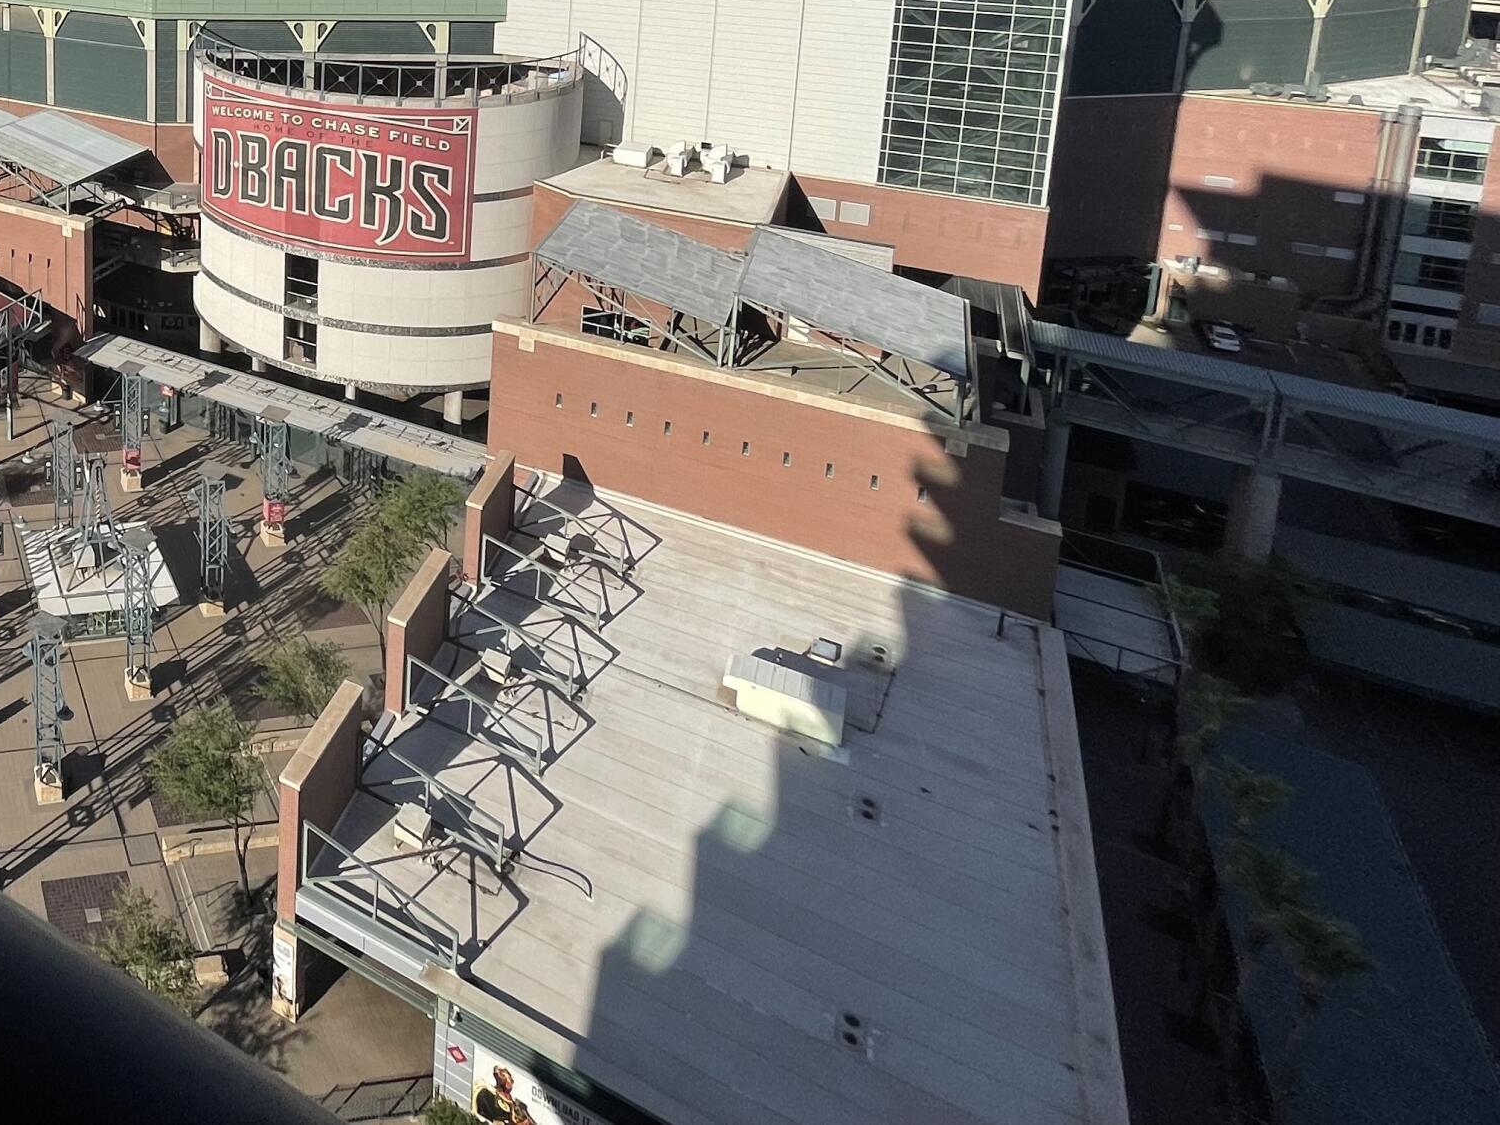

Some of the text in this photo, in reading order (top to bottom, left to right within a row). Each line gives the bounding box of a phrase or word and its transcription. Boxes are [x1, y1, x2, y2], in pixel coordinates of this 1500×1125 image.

[212, 106, 451, 152] WELCOME TO CHASE FIELD
[254, 124, 373, 148] HOME OF THE
